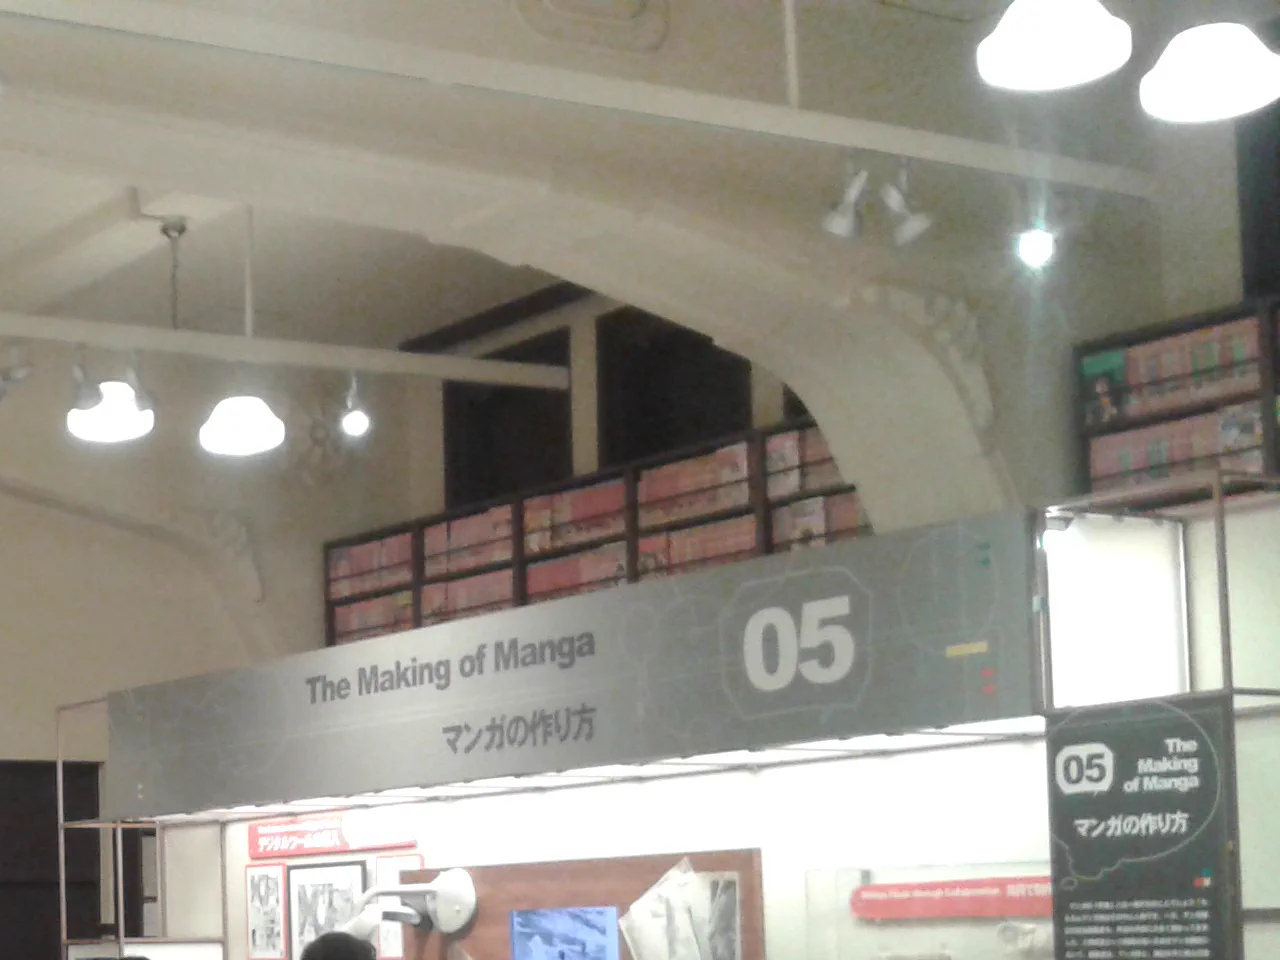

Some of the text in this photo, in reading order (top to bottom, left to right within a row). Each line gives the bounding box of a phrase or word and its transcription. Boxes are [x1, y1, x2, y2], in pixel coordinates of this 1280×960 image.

[743, 595, 856, 692] 05
[305, 632, 595, 704] The Making of Manga
[441, 703, 597, 754] マンガの作り方
[1164, 738, 1198, 753] The
[1062, 753, 1107, 785] 05
[1137, 756, 1199, 773] Making
[1123, 775, 1199, 792] of Manga
[1074, 809, 1190, 838] マンガの作り方
